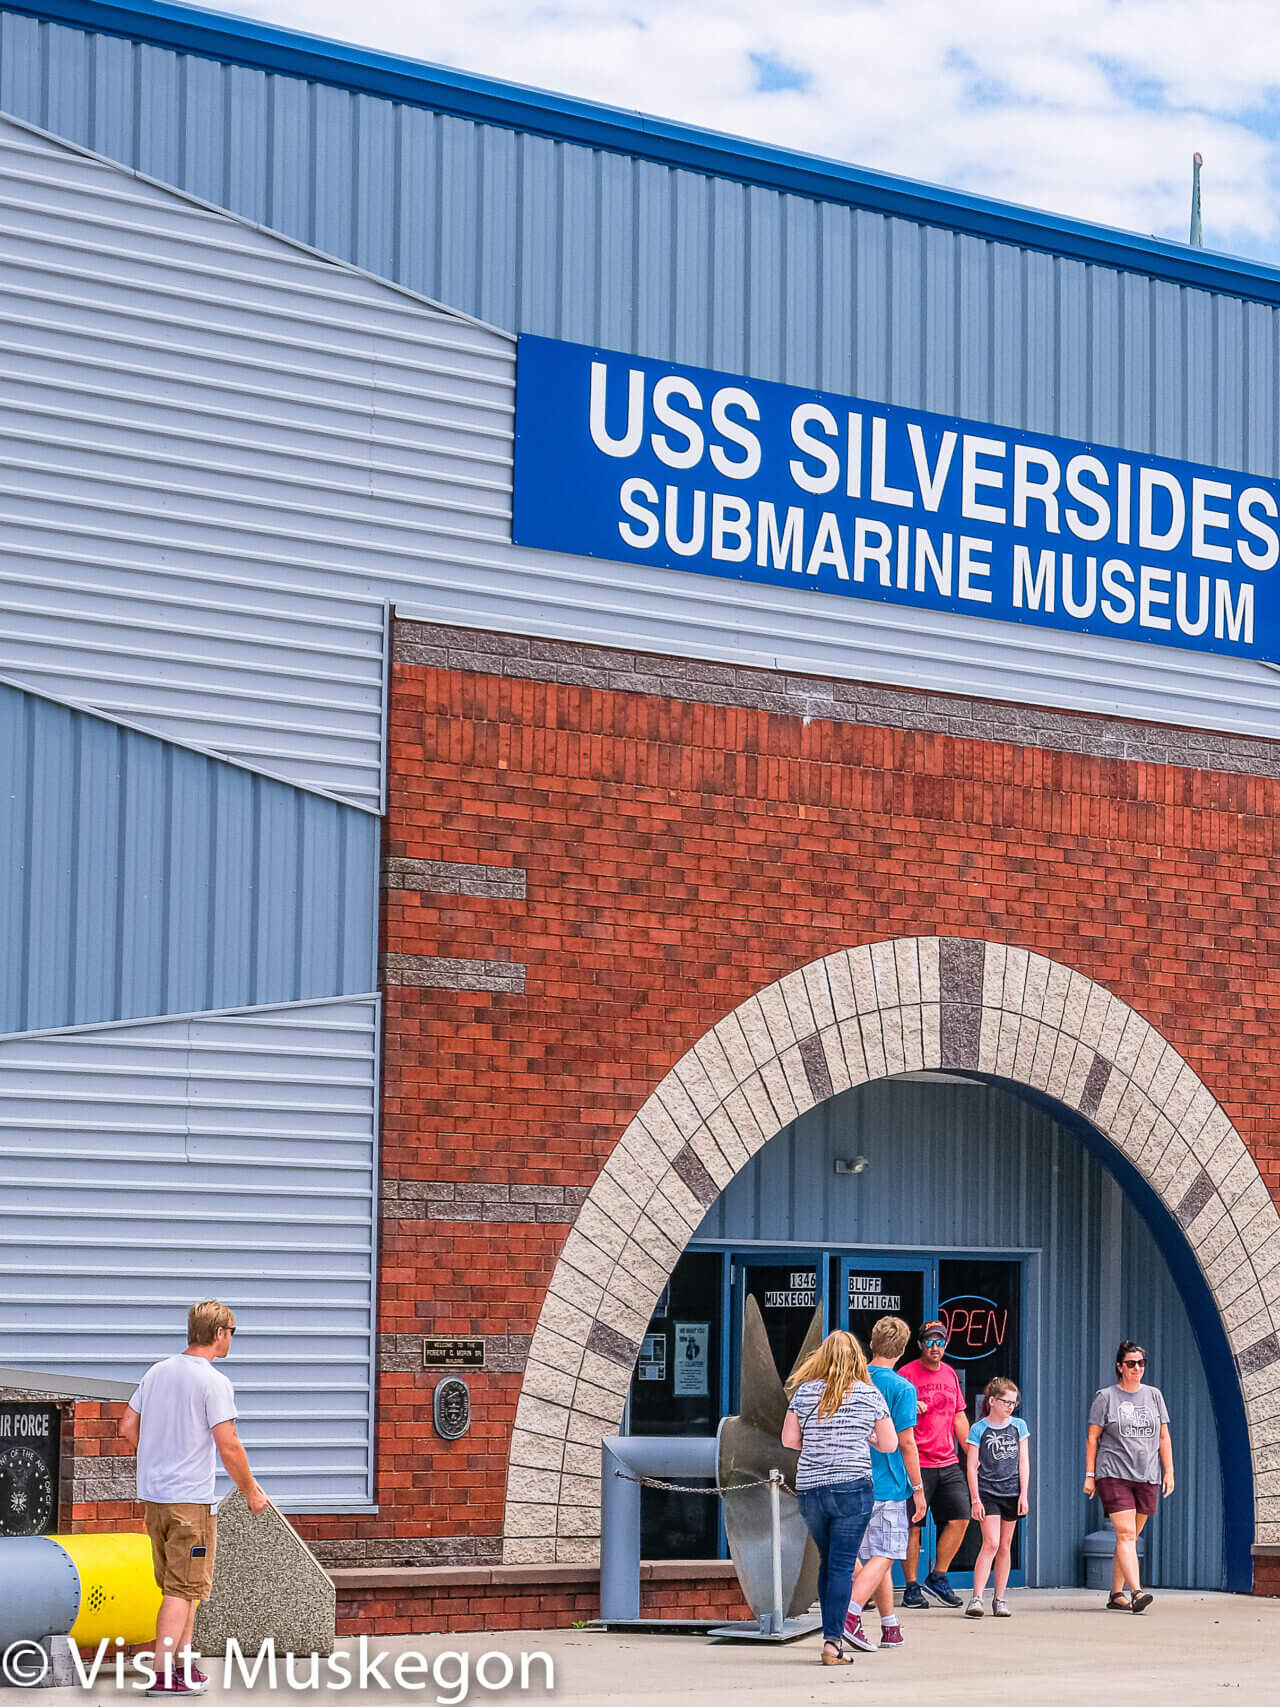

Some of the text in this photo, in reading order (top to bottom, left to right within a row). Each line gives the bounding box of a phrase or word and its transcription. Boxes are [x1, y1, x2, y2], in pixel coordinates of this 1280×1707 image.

[588, 361, 762, 480] USS
[618, 477, 1257, 646] SUBMARINE MUSEUM
[791, 1273, 881, 1291] 1346 BLUFF
[765, 1292, 900, 1310] MUSKEGON MICHIGAN
[0, 1414, 48, 1437] IR FORCE
